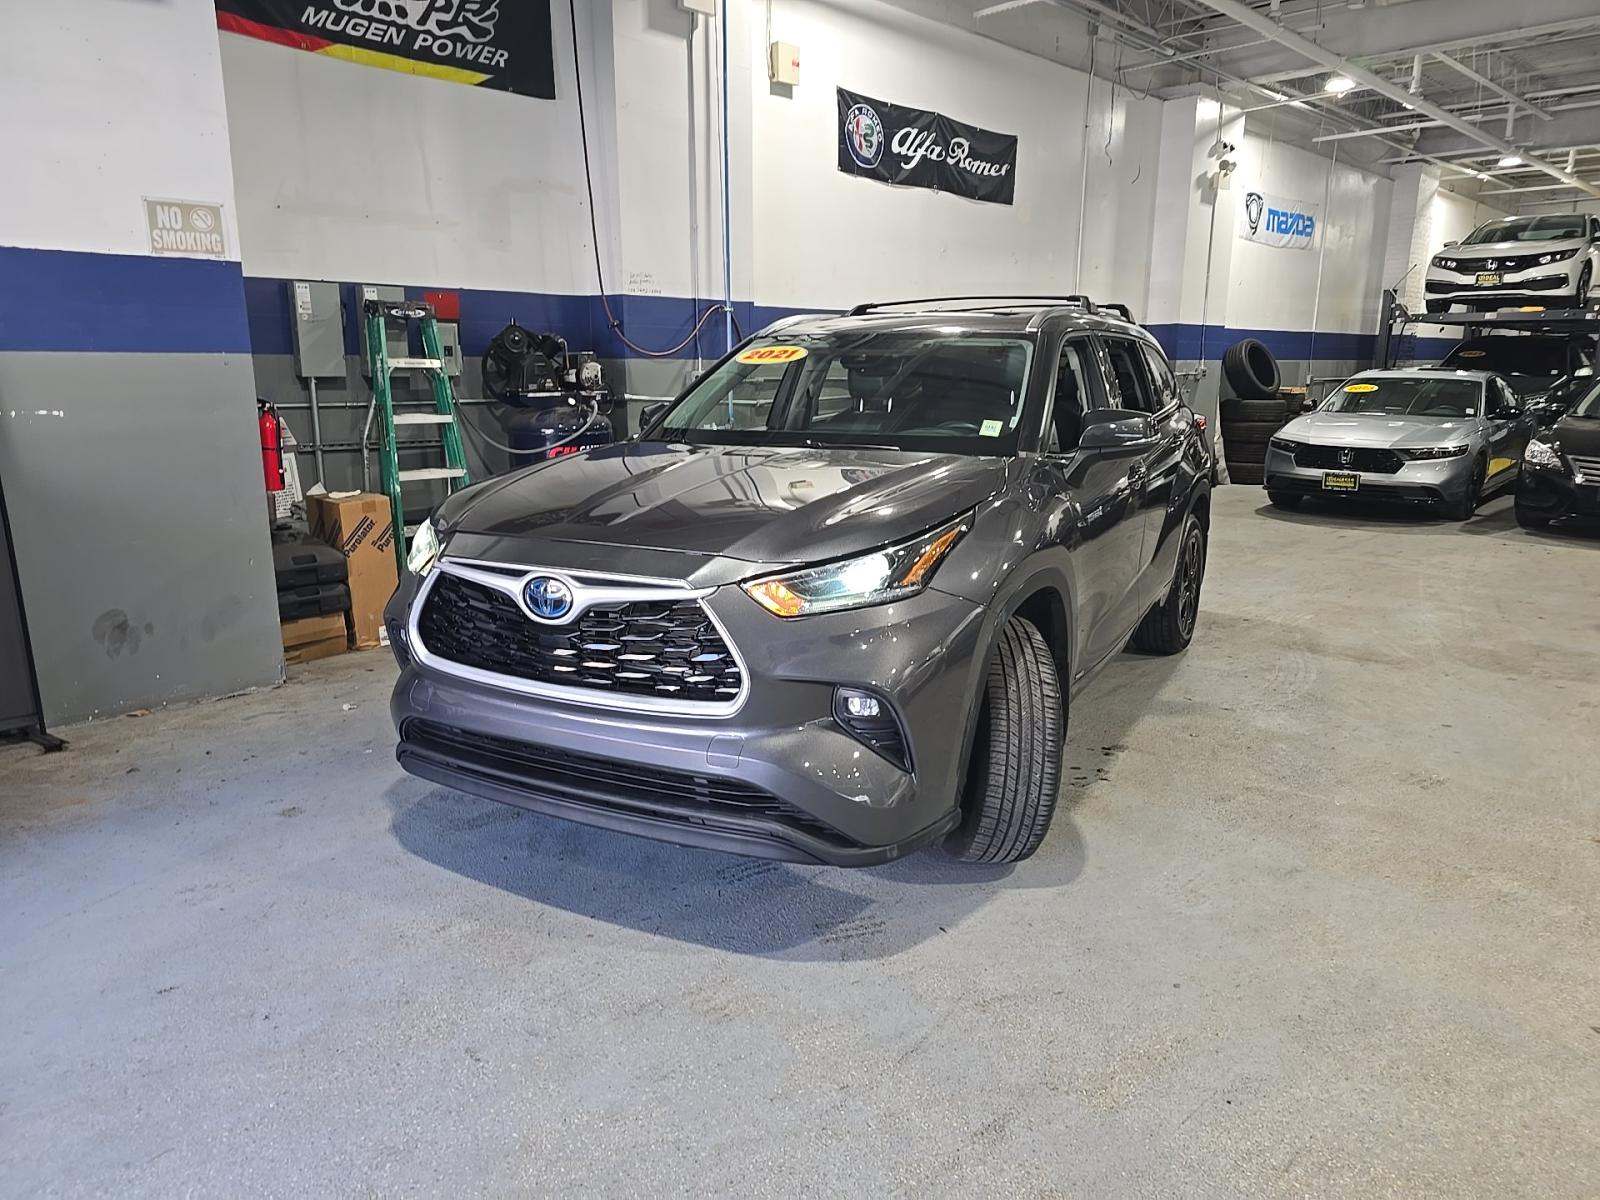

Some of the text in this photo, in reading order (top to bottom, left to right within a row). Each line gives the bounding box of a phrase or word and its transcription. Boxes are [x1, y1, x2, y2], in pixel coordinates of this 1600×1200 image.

[301, 6, 406, 46] MUGEN
[413, 33, 509, 68] POWER
[891, 127, 945, 170] Alfa
[156, 205, 182, 230] NO
[1266, 208, 1315, 237] mazda
[152, 229, 223, 252] SMOKING
[743, 349, 799, 360] 2021
[344, 520, 376, 558] Purolator
